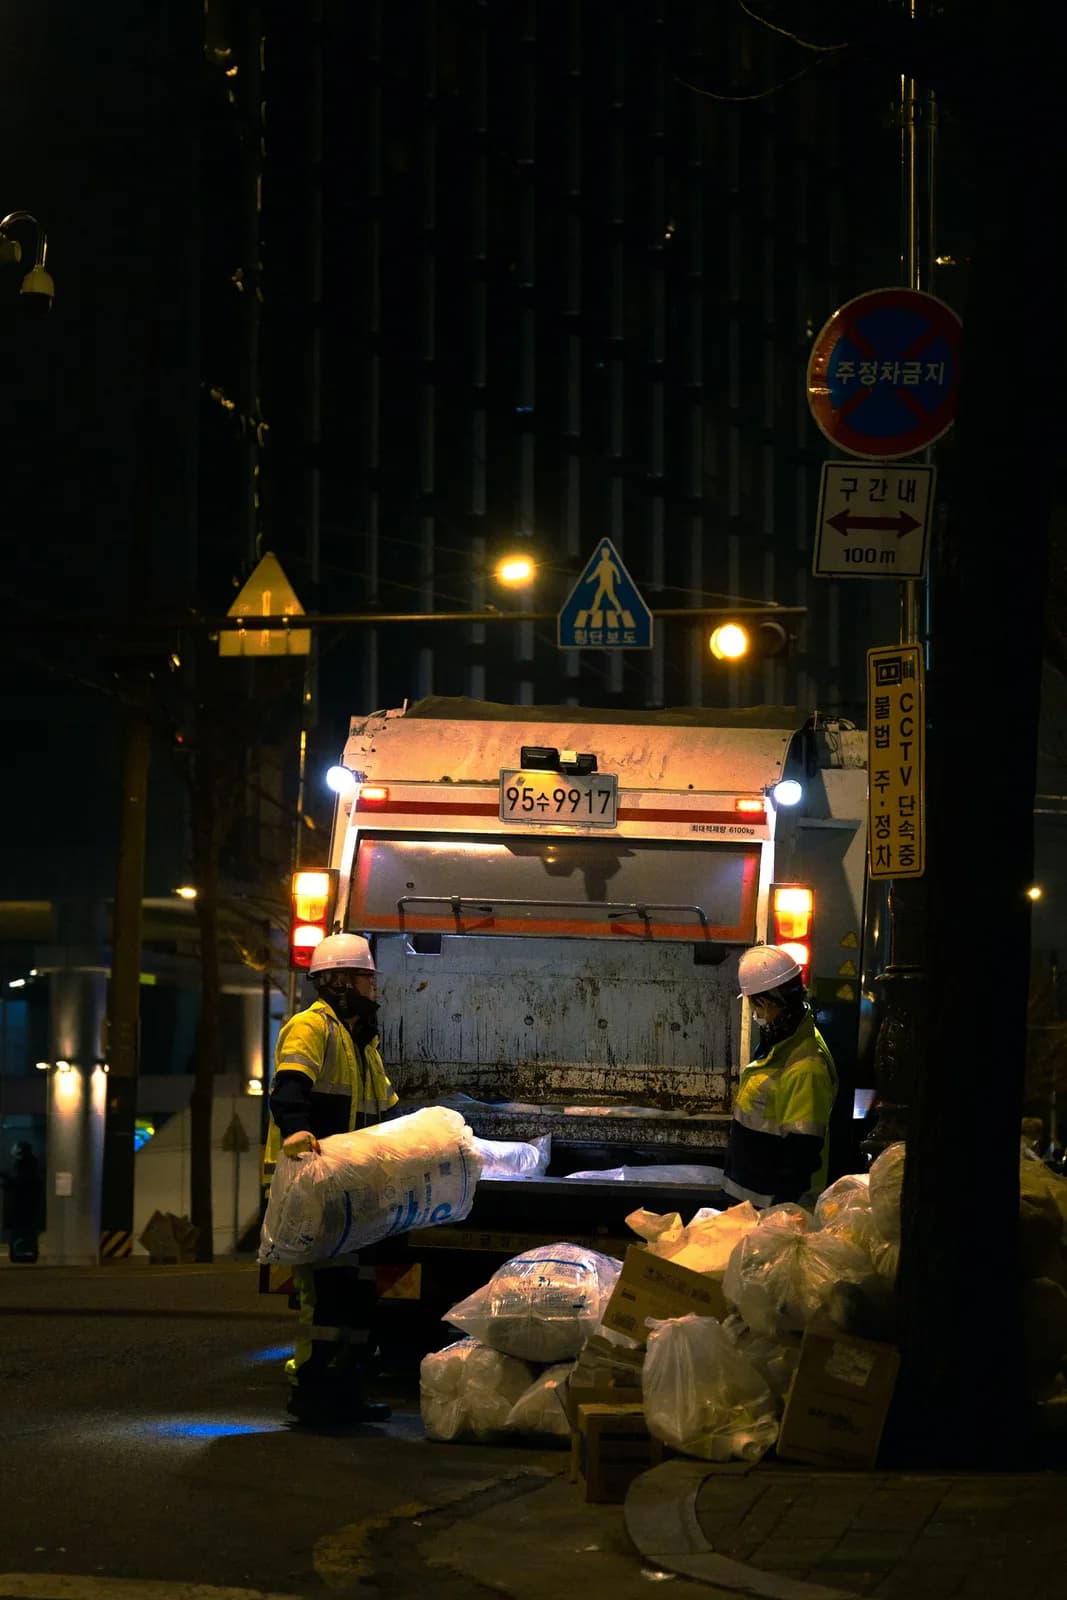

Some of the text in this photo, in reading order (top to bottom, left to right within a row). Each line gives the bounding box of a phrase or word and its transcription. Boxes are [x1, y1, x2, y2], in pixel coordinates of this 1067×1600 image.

[835, 360, 946, 387] 주정차금지
[843, 547, 896, 564] 100m
[875, 696, 890, 748] 불법
[898, 692, 917, 867] CCTV 단속중
[506, 787, 611, 814] 95수9917
[729, 827, 755, 835] 6100kg
